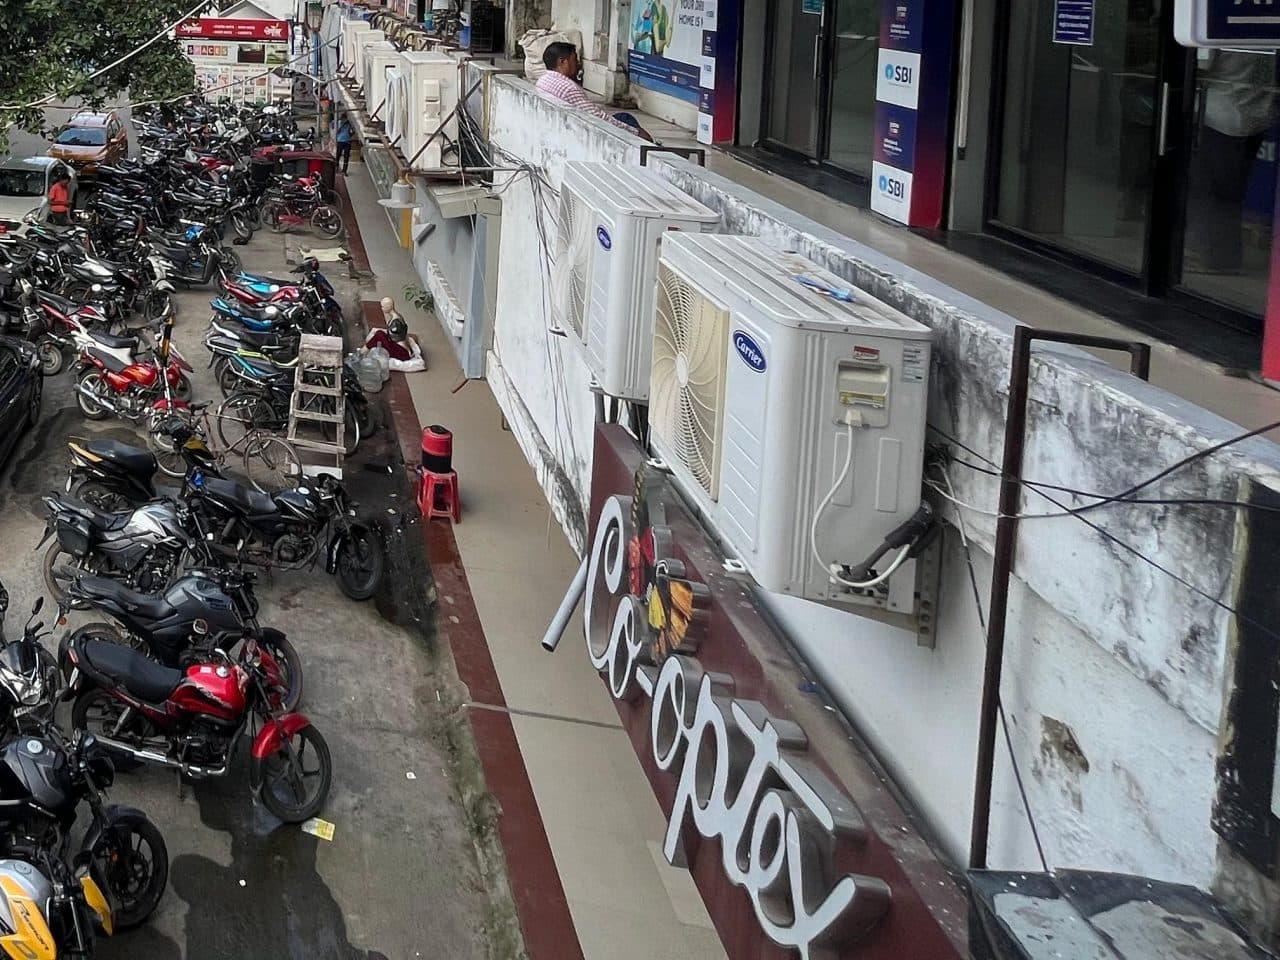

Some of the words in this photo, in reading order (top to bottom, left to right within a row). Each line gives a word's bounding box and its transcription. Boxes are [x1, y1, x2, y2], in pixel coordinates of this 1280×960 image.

[680, 0, 695, 10] YOUR
[678, 14, 695, 26] HOME
[894, 65, 912, 84] SBI
[887, 178, 904, 199] SBI
[736, 335, 763, 367] Carrier
